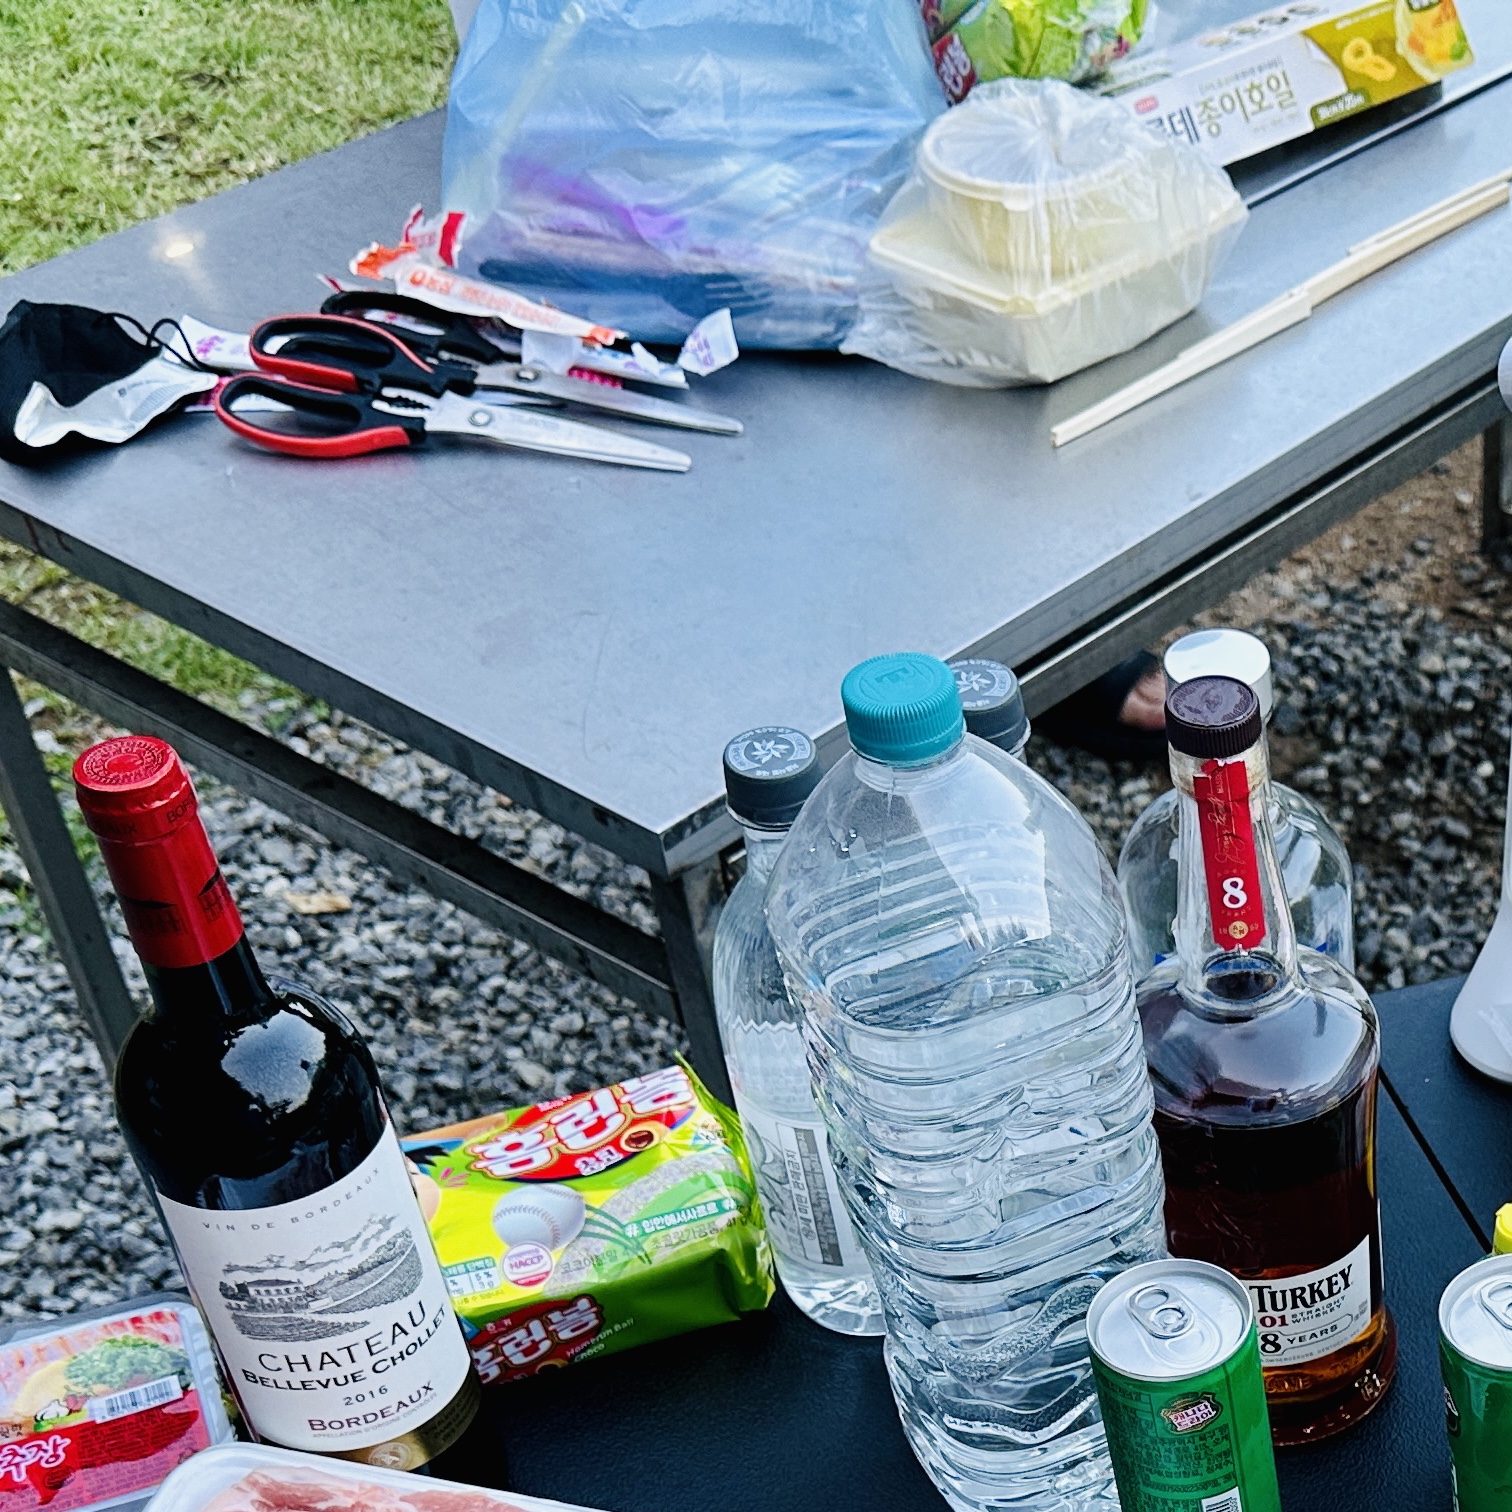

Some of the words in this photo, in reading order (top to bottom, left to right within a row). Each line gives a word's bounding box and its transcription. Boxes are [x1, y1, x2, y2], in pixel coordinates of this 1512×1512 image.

[1221, 876, 1248, 909] 8
[468, 1065, 694, 1179] 홈런볼
[202, 1220, 236, 1232] VIN
[251, 1221, 276, 1232] DE
[290, 1167, 381, 1225] BORDEAUX
[508, 1255, 545, 1272] HACCP
[1248, 1262, 1353, 1314] TURKEY
[257, 1300, 428, 1374] CHATEAU
[1259, 1314, 1290, 1329] 01
[1260, 1333, 1283, 1355] 8
[1286, 1324, 1339, 1346] YEARS
[241, 1367, 367, 1391] BELLEVUE
[371, 1304, 446, 1374] CHOLLET
[307, 1379, 435, 1432] BORDEAUX
[343, 1384, 389, 1407] 2016
[0, 1434, 72, 1483] 추장
